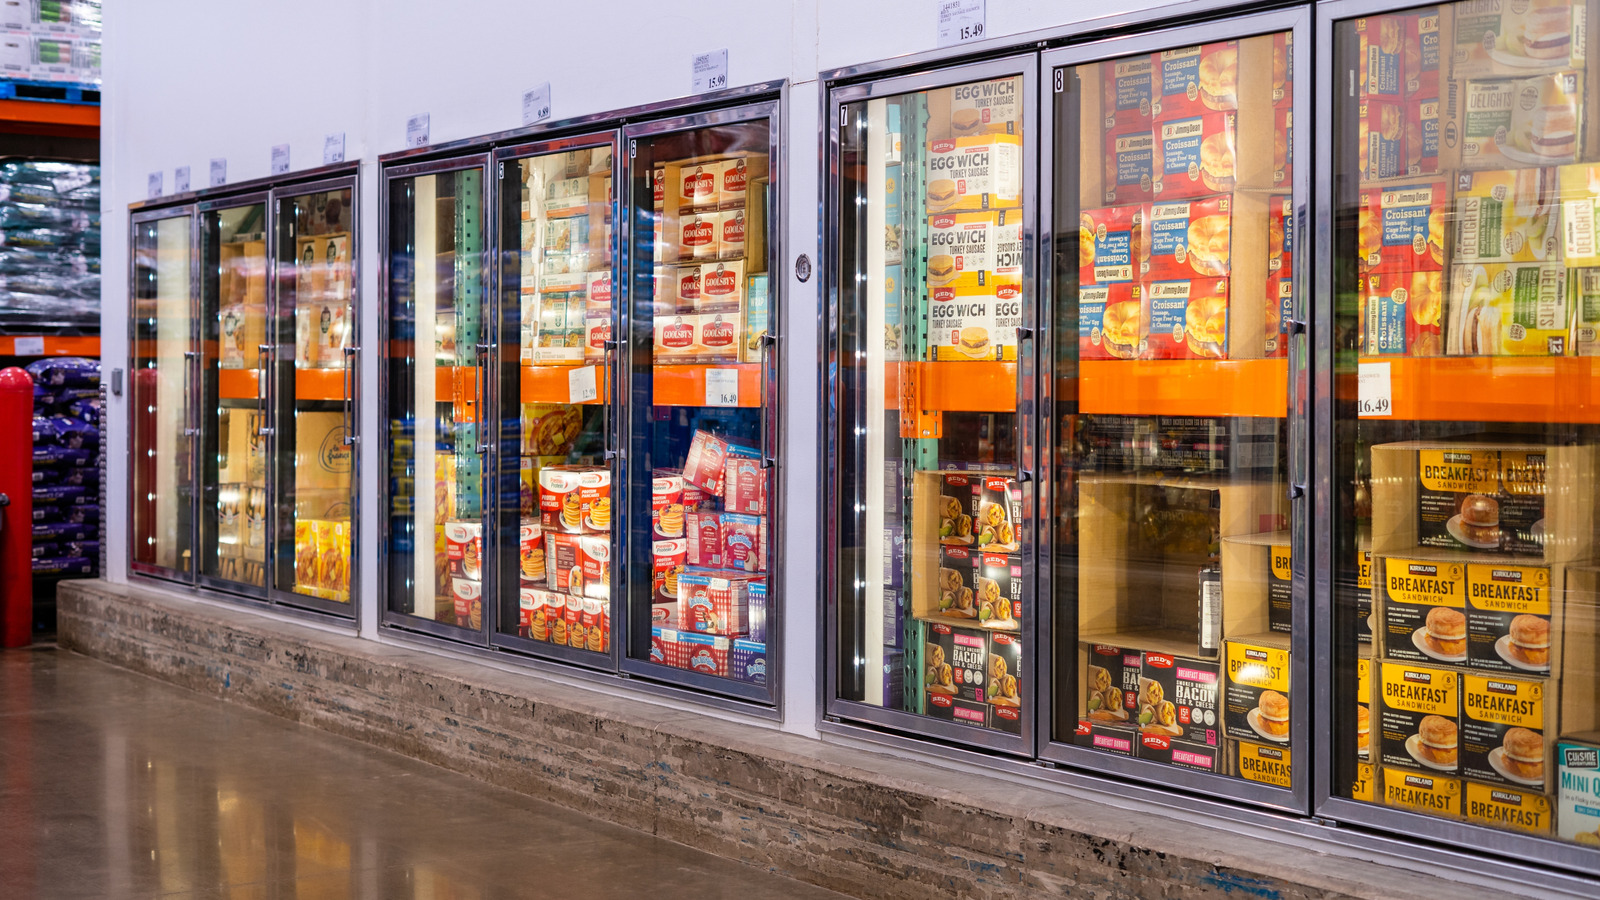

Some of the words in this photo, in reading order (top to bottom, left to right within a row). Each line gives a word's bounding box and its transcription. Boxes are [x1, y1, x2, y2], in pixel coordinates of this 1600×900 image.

[960, 24, 983, 40] 15.49
[1164, 59, 1197, 71] Croissant
[708, 74, 725, 89] 15.99
[1056, 70, 1062, 91] 8
[1118, 76, 1150, 88] Croissant
[975, 97, 992, 108] TURKEY
[993, 95, 1014, 106] SAUSAGE
[1470, 92, 1512, 108] DELIGHTS
[537, 106, 549, 118] 9.89
[842, 106, 847, 125] 7
[416, 135, 428, 146] 15.99
[1165, 139, 1199, 150] Croissant
[631, 141, 636, 157] 6
[1119, 152, 1151, 162] Croissant
[950, 169, 967, 179] TURKEY
[968, 167, 989, 178] SAUSAGE
[685, 178, 713, 190] GOOLSBY'S
[1460, 174, 1470, 189] 12
[1219, 200, 1228, 208] 12
[1386, 209, 1426, 219] Croissant
[1153, 221, 1186, 231] Croissant
[1463, 200, 1478, 255] DELIGHTS
[1574, 201, 1591, 254] DELIGHTS
[684, 227, 712, 238] GOOLSBY'S
[949, 245, 966, 255] TURKEY
[965, 244, 986, 254] SAUSAGE
[1097, 254, 1128, 263] Croissant
[705, 277, 734, 287] GOOLSBY'S
[935, 291, 954, 299] RED'S
[998, 288, 1018, 296] RED'S
[1132, 287, 1140, 295] 12
[1540, 269, 1556, 327] DELIGHTS
[1152, 300, 1185, 310] Croissant
[932, 319, 946, 329] TURKEY
[946, 318, 962, 328] SAUSAGE
[664, 330, 692, 339] GOOLSBY'S
[703, 329, 733, 338] GOOLSBY'S
[1553, 338, 1562, 354] 12
[720, 394, 737, 403] 16.49
[1358, 398, 1389, 412] 16.49
[1425, 465, 1488, 482] BREAKFAST
[1438, 481, 1478, 490] SANDWICH
[985, 556, 1006, 565] RED'S
[1409, 564, 1437, 573] KIRKLAND
[1453, 567, 1457, 575] 8
[1493, 570, 1521, 578] KIRKLAND
[1391, 577, 1455, 595] BREAKFAST
[1402, 593, 1443, 603] SANDWICH
[1473, 583, 1541, 602] BREAKFAST
[1484, 600, 1528, 610] SANDWICH
[953, 650, 983, 664] BACON
[1246, 650, 1267, 658] KIRKLAND
[1148, 656, 1172, 666] RED'S
[1178, 669, 1198, 679] BREAKFAST
[1405, 671, 1430, 680] KIRKLAND
[1176, 680, 1194, 688] SMOKED
[1446, 676, 1451, 684] 8
[1488, 681, 1516, 691] KIRKLAND
[1534, 687, 1539, 695] 8
[1175, 686, 1216, 703] BACON
[1386, 682, 1448, 704] BREAKFAST
[1188, 698, 1193, 706] &
[1195, 700, 1215, 709] CHEESE
[1396, 699, 1437, 711] SANDWICH
[1468, 692, 1535, 716] BREAKFAST
[1479, 710, 1522, 723] SANDWICH
[1094, 736, 1113, 746] BREAKFAST
[1114, 739, 1130, 750] BURRITO
[1144, 737, 1168, 747] RED'S
[1259, 748, 1282, 757] KIRKLAND
[1567, 751, 1596, 762] CUISINE
[1173, 751, 1193, 761] BREAKFAST
[1194, 754, 1212, 766] BURRITO
[1253, 772, 1288, 785] SANDWICH
[1406, 775, 1432, 786] KIRKLAND
[1562, 771, 1589, 793] MINI
[1389, 786, 1451, 810] BREAKFAST
[1492, 791, 1521, 801] KIRKLAND
[1575, 796, 1589, 805] flaky
[1539, 799, 1544, 807] 8
[1471, 801, 1540, 827] BREAKFAST
